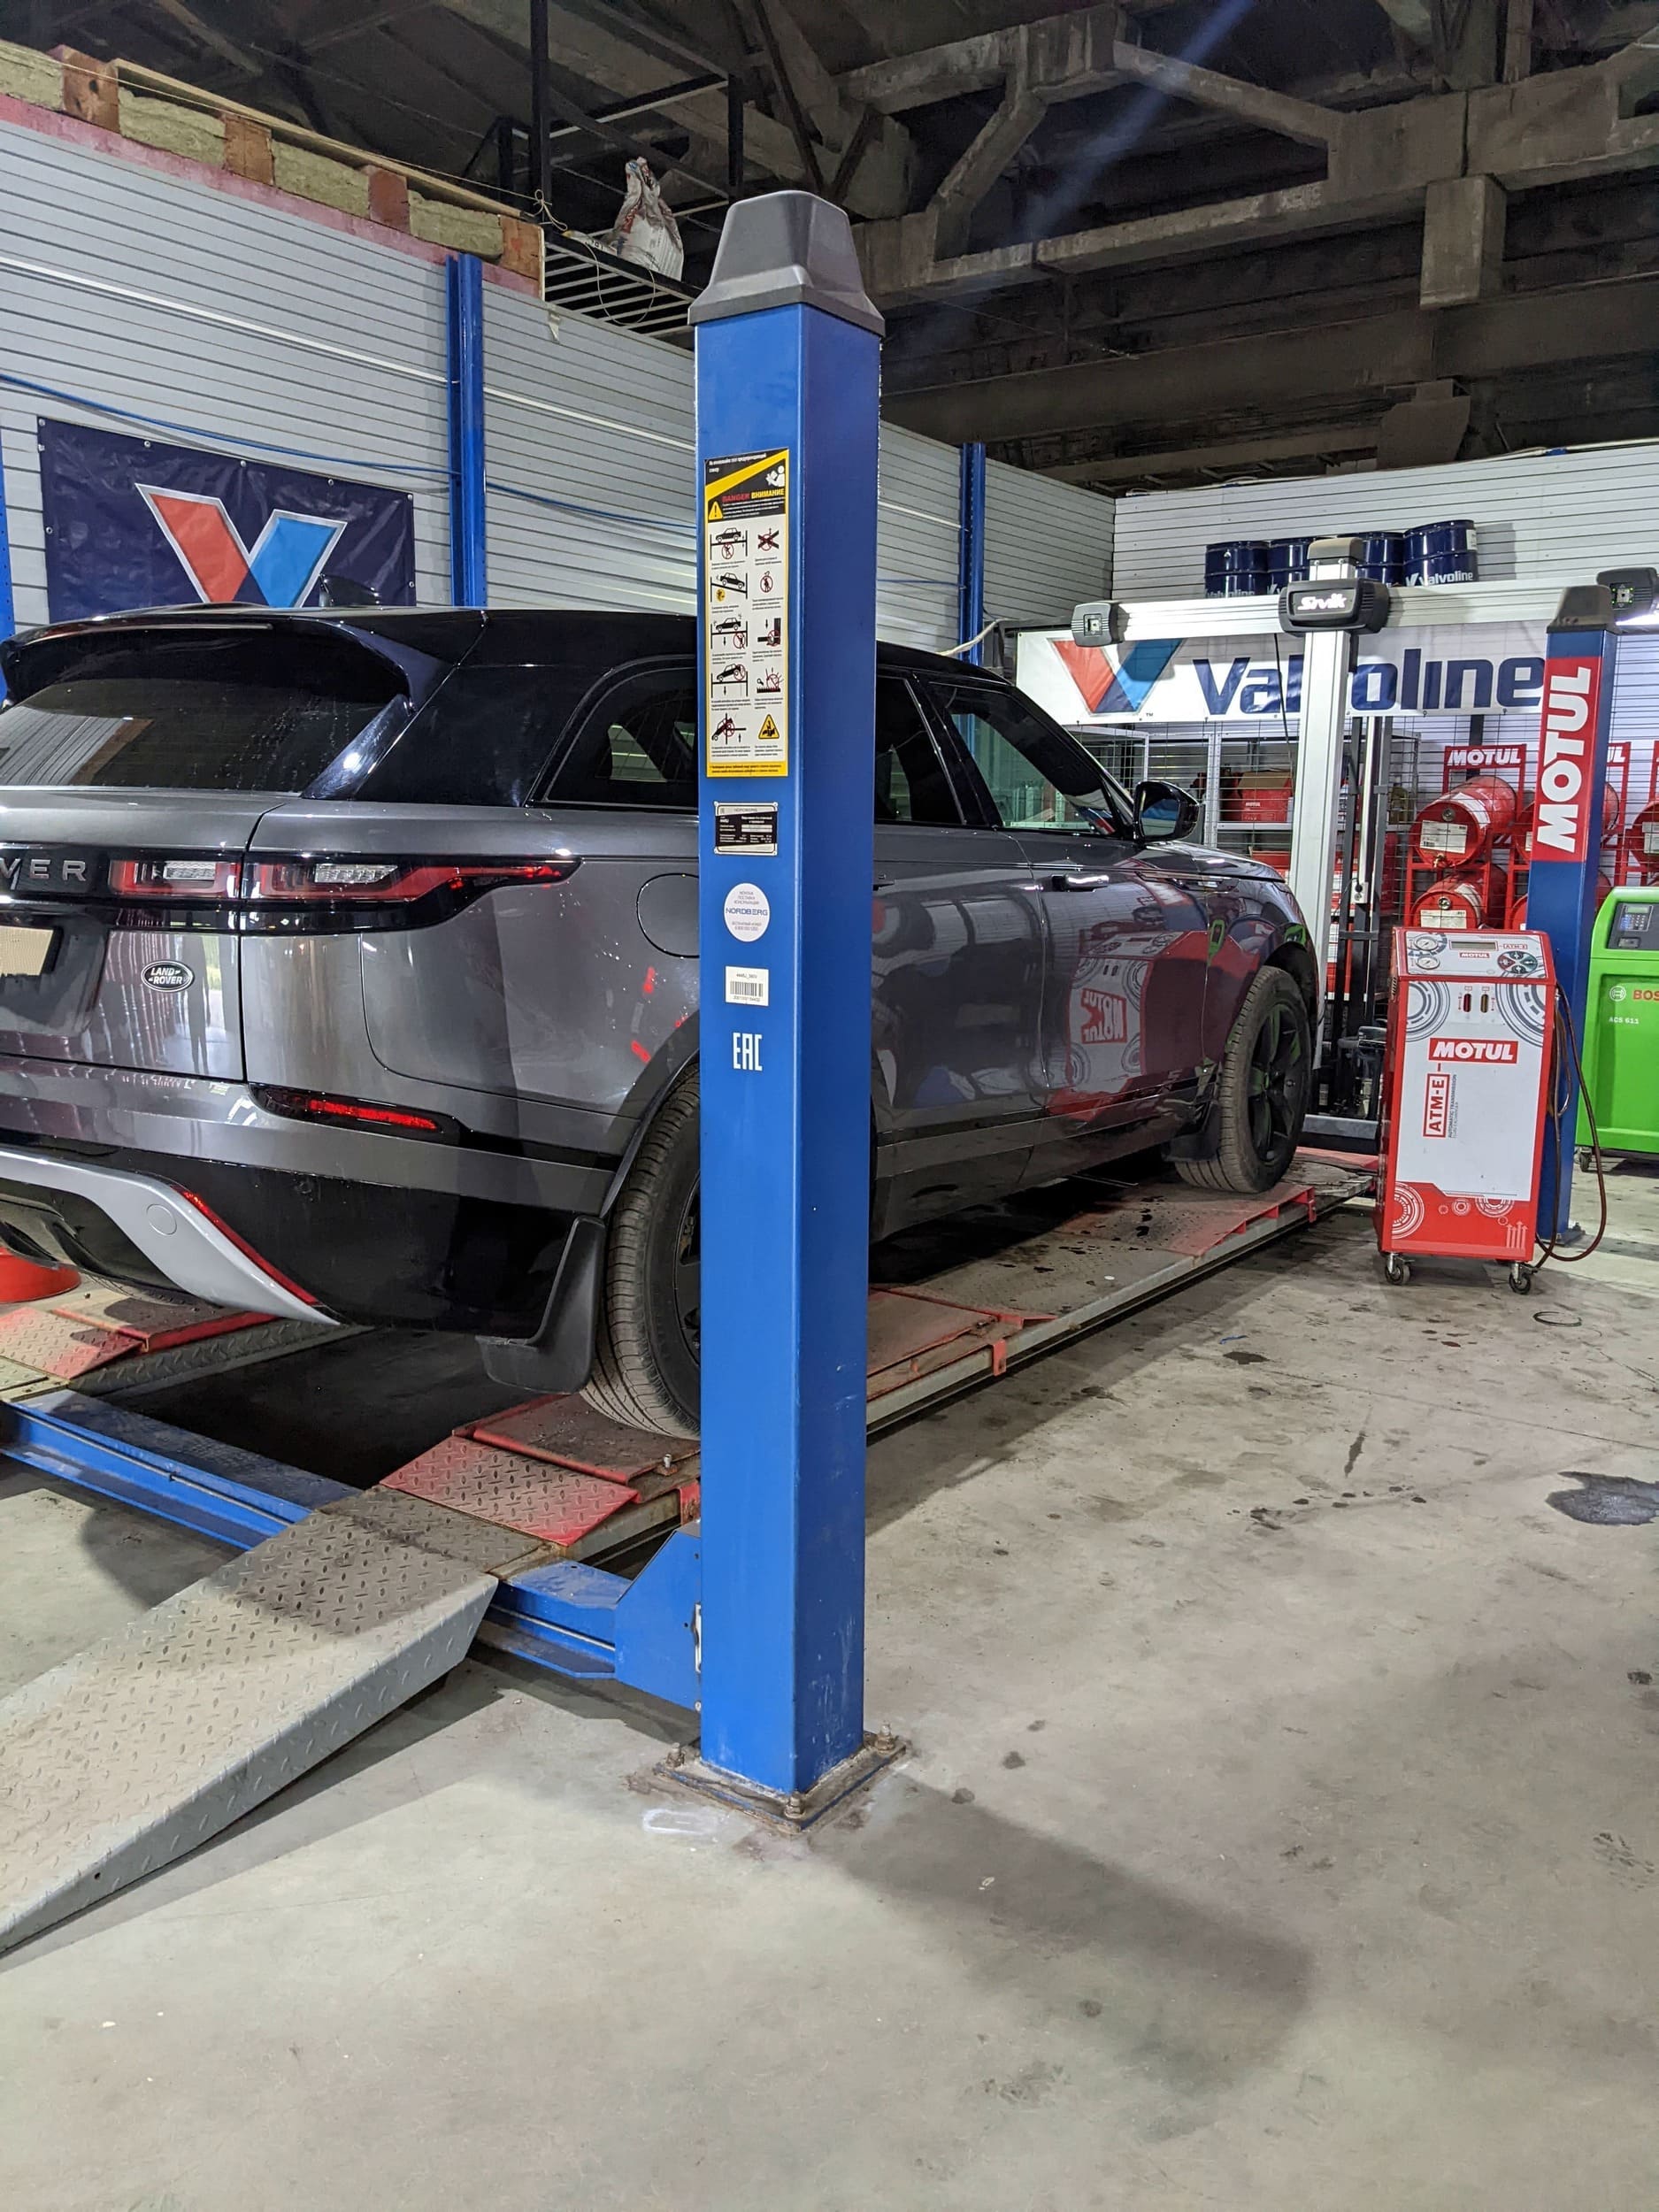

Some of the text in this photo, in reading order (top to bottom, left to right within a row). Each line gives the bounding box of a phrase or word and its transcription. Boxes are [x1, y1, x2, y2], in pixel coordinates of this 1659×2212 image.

[1192, 648, 1545, 716] Valoline
[1447, 748, 1521, 765] MOTUL
[1537, 665, 1591, 853] MOTUL
[726, 907, 768, 916] NORDBERG
[153, 975, 183, 984] ROVER
[733, 1032, 763, 1071] EAC
[1432, 1041, 1514, 1060] MOTUL
[1429, 1079, 1444, 1132] ATM-E
